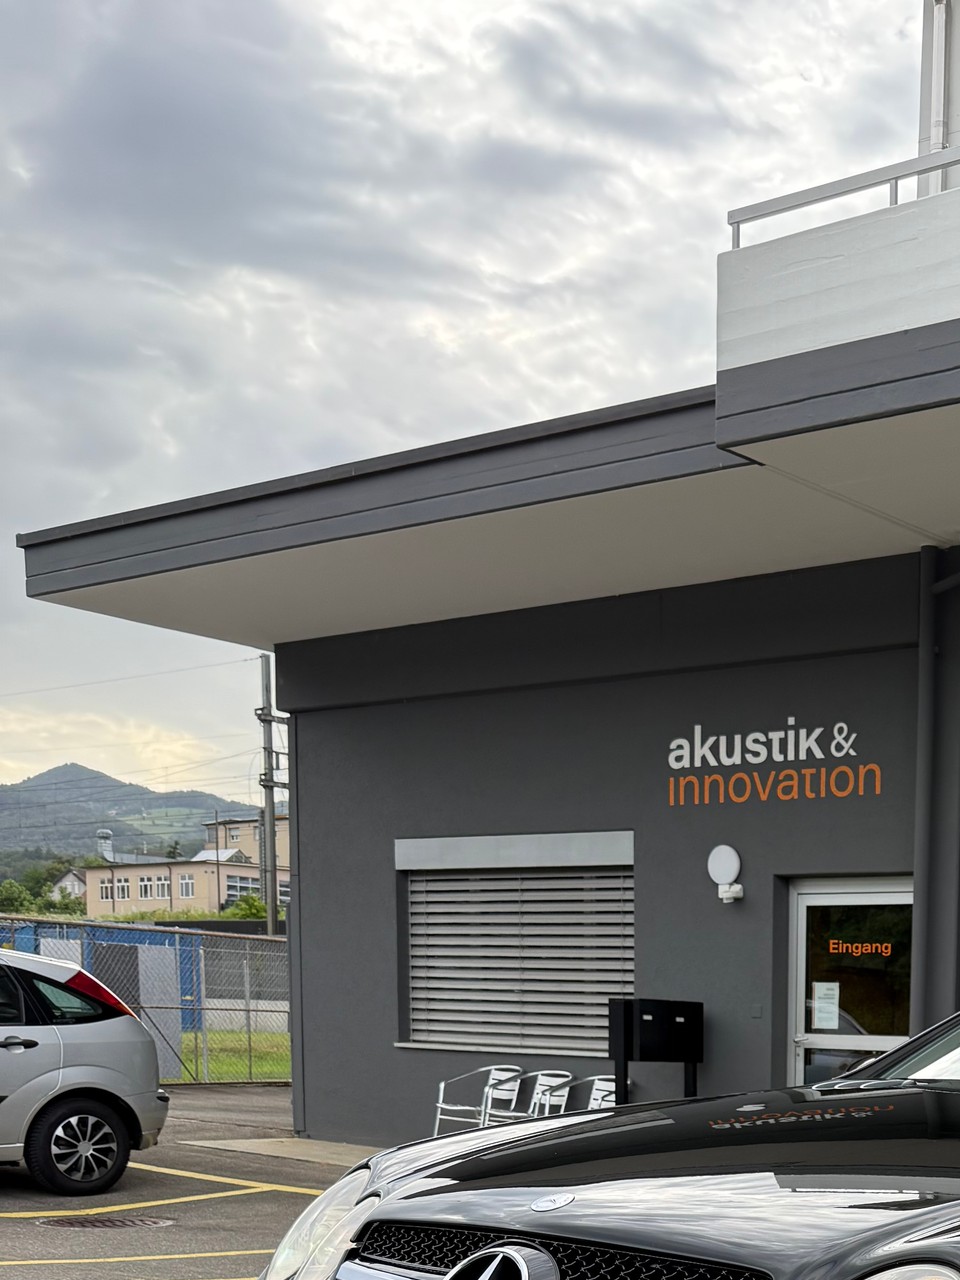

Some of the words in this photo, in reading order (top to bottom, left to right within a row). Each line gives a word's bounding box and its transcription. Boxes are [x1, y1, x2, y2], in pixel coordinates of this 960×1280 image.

[668, 716, 825, 770] akustik
[830, 722, 858, 758] &
[668, 762, 882, 807] innovation
[828, 939, 892, 957] Eingang
